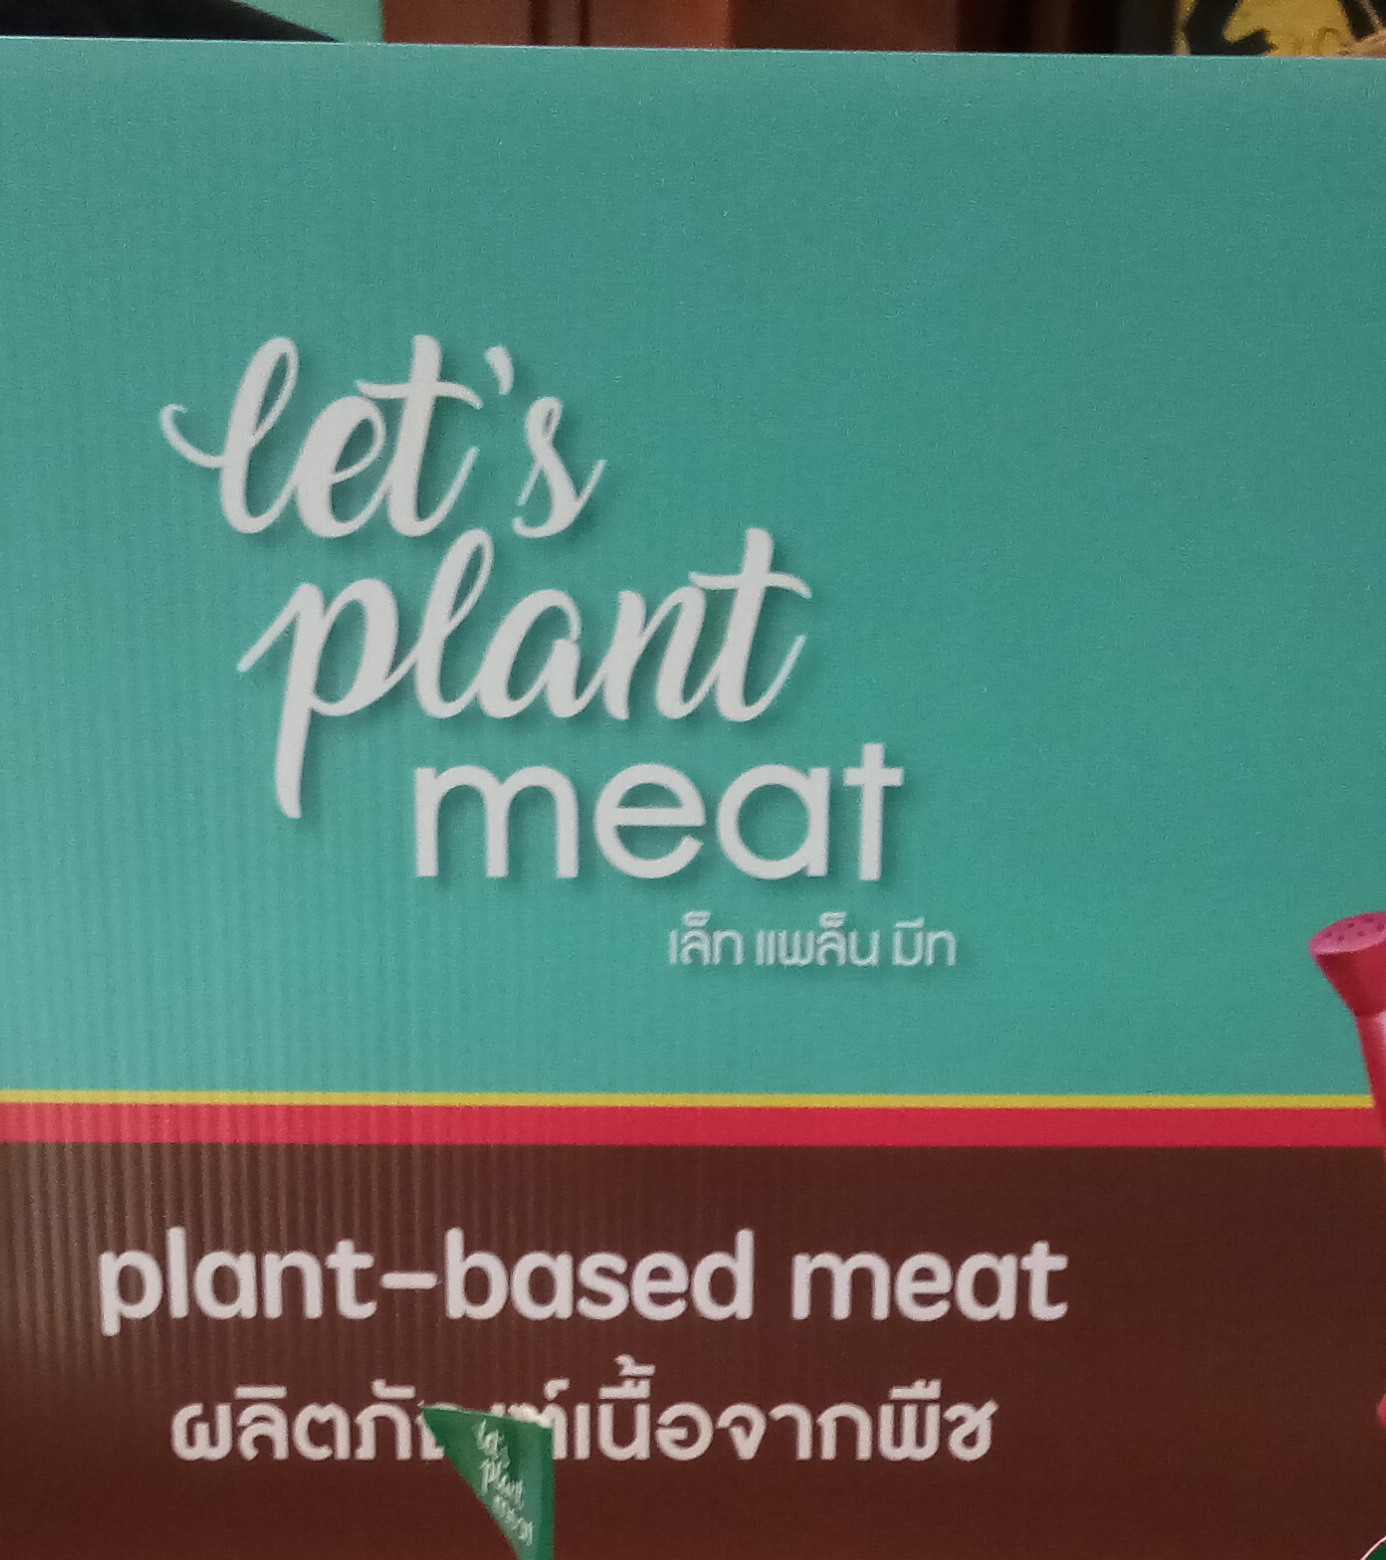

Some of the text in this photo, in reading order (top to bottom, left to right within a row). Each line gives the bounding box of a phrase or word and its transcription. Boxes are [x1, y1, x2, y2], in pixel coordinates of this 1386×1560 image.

[159, 333, 608, 540] let's
[236, 526, 812, 819] plant
[414, 742, 905, 882] meat
[98, 1226, 1069, 1336] plant-based meat
